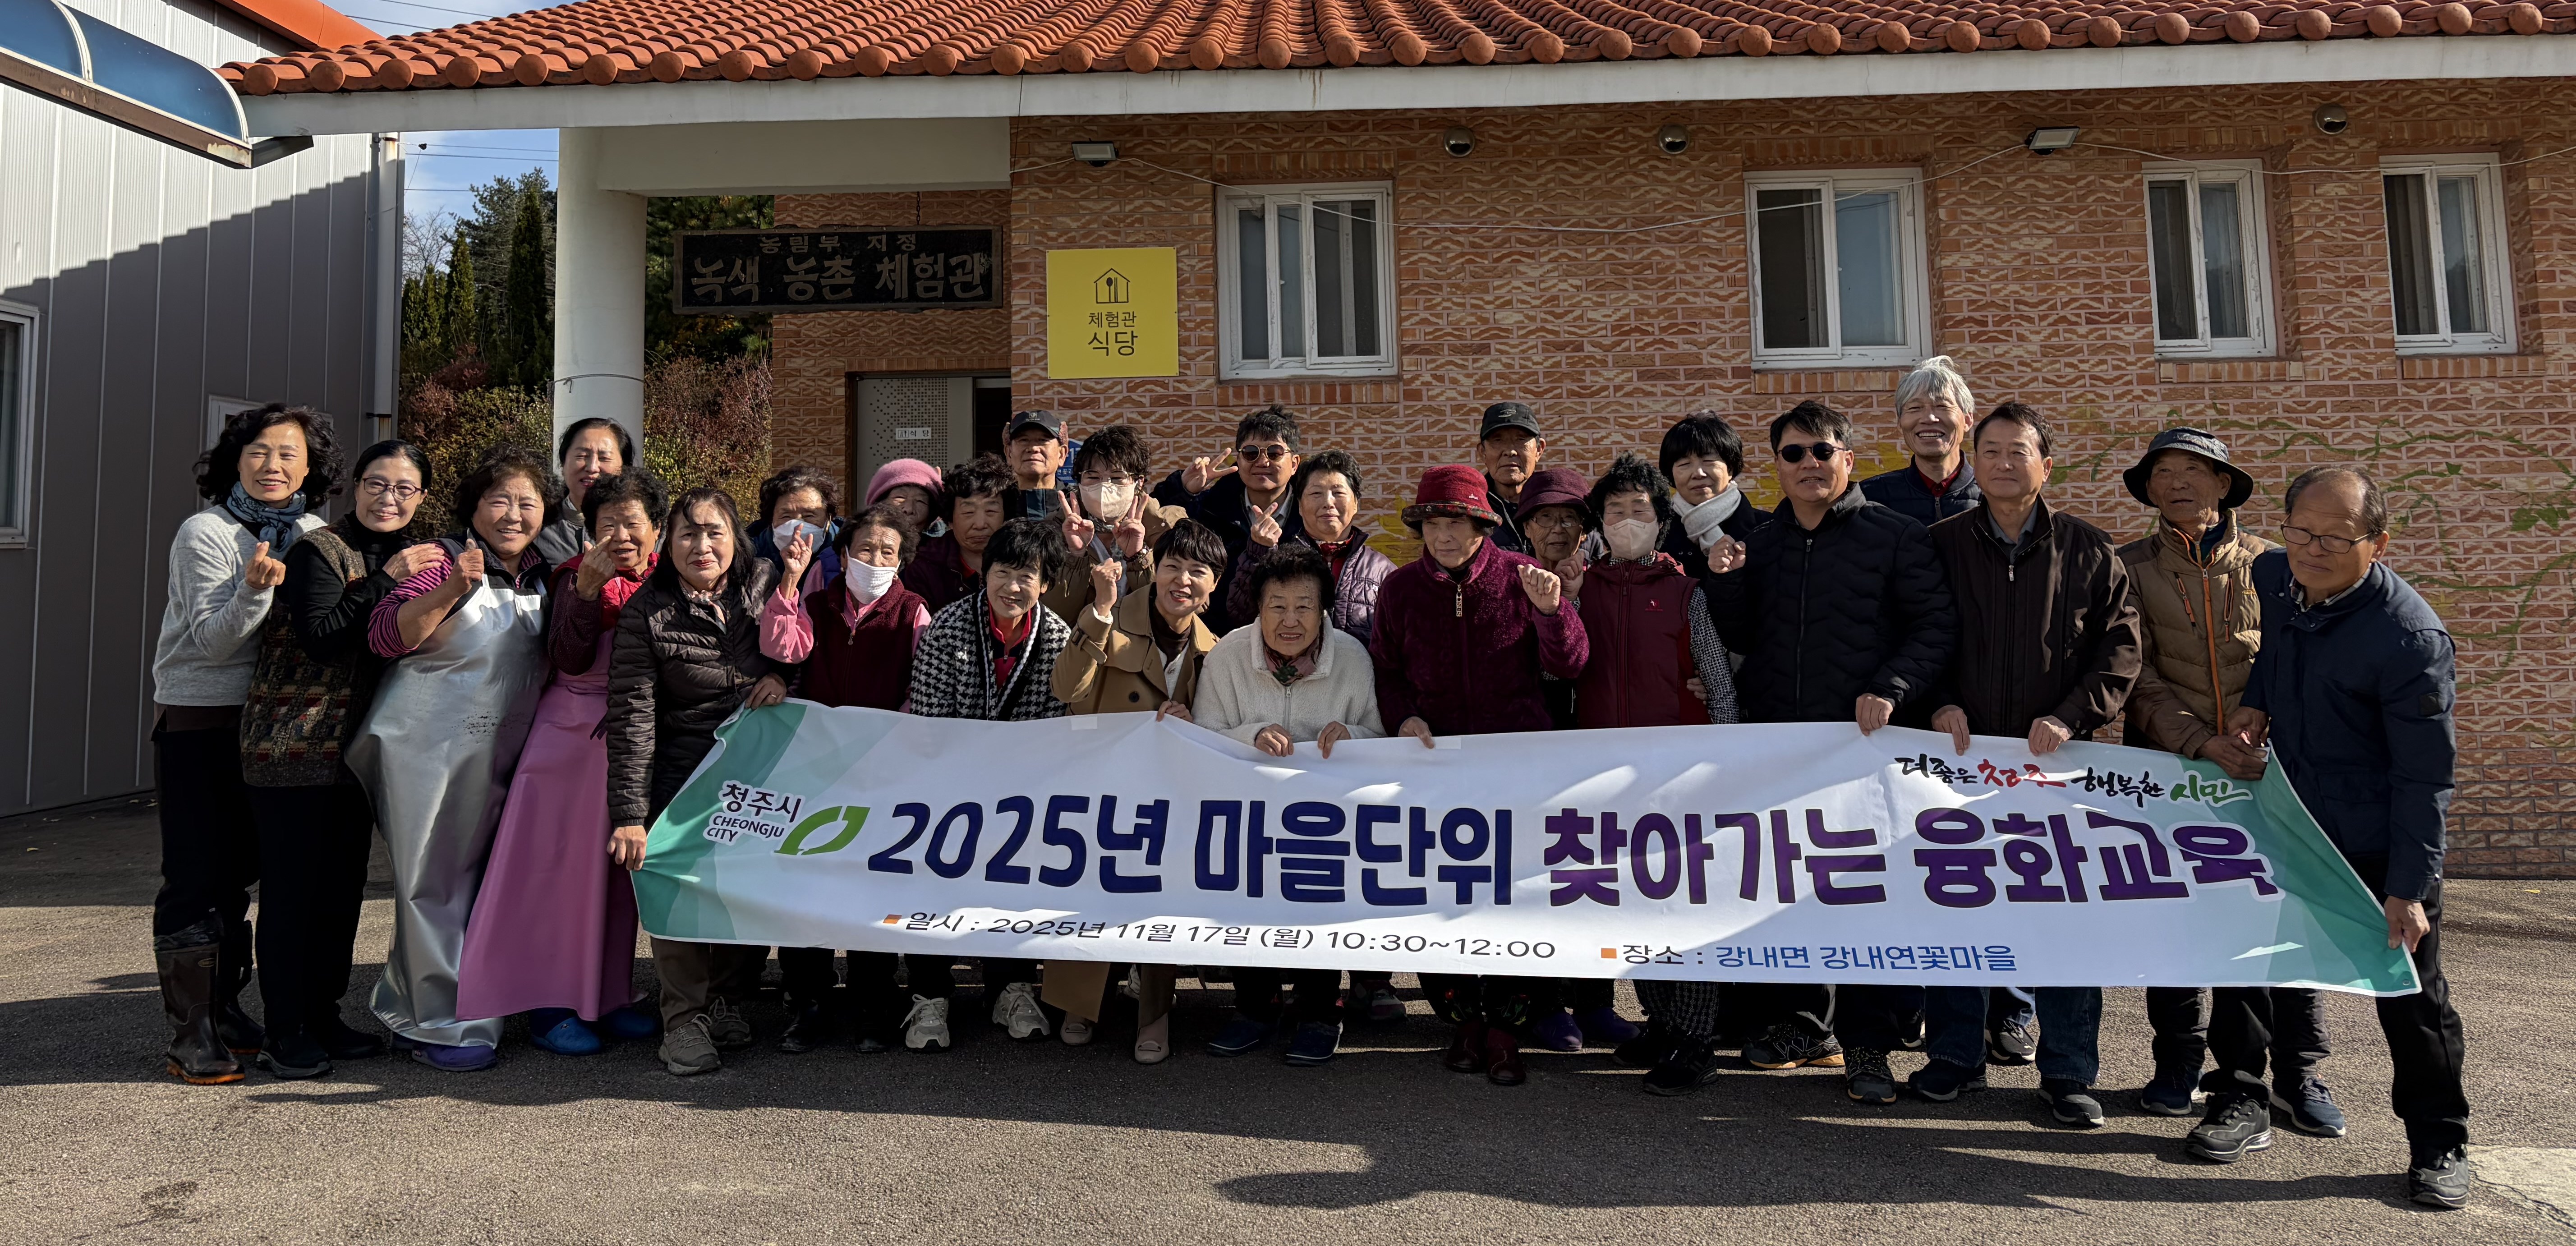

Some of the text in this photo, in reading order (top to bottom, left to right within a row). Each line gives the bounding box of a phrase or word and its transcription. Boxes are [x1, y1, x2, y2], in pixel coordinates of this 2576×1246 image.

[759, 234, 916, 254] 농림부 지정
[691, 252, 985, 303] 녹색 농촌 체험관
[1088, 311, 1137, 328] 체험관
[1088, 330, 1138, 356] 식당
[1977, 759, 2067, 788] 청주
[2070, 767, 2165, 808] 행복한
[2170, 774, 2249, 804] 시민
[722, 784, 802, 823] 청주시
[707, 828, 739, 842] CITY
[713, 815, 785, 838] CHEONGJU
[868, 795, 2278, 908] 2025년 마을단위 찾아가는 융화교육
[906, 912, 964, 933] 일시
[987, 919, 1106, 938] 2025년
[1118, 920, 1177, 942] 11월
[1188, 926, 1251, 946] 17일
[1260, 928, 1313, 949] (월)
[1327, 932, 1555, 958] 10:30~12:00
[1623, 945, 1684, 965] 장소
[1717, 946, 1812, 970] 강내면
[1819, 945, 2018, 972] 강내연꽃마을
